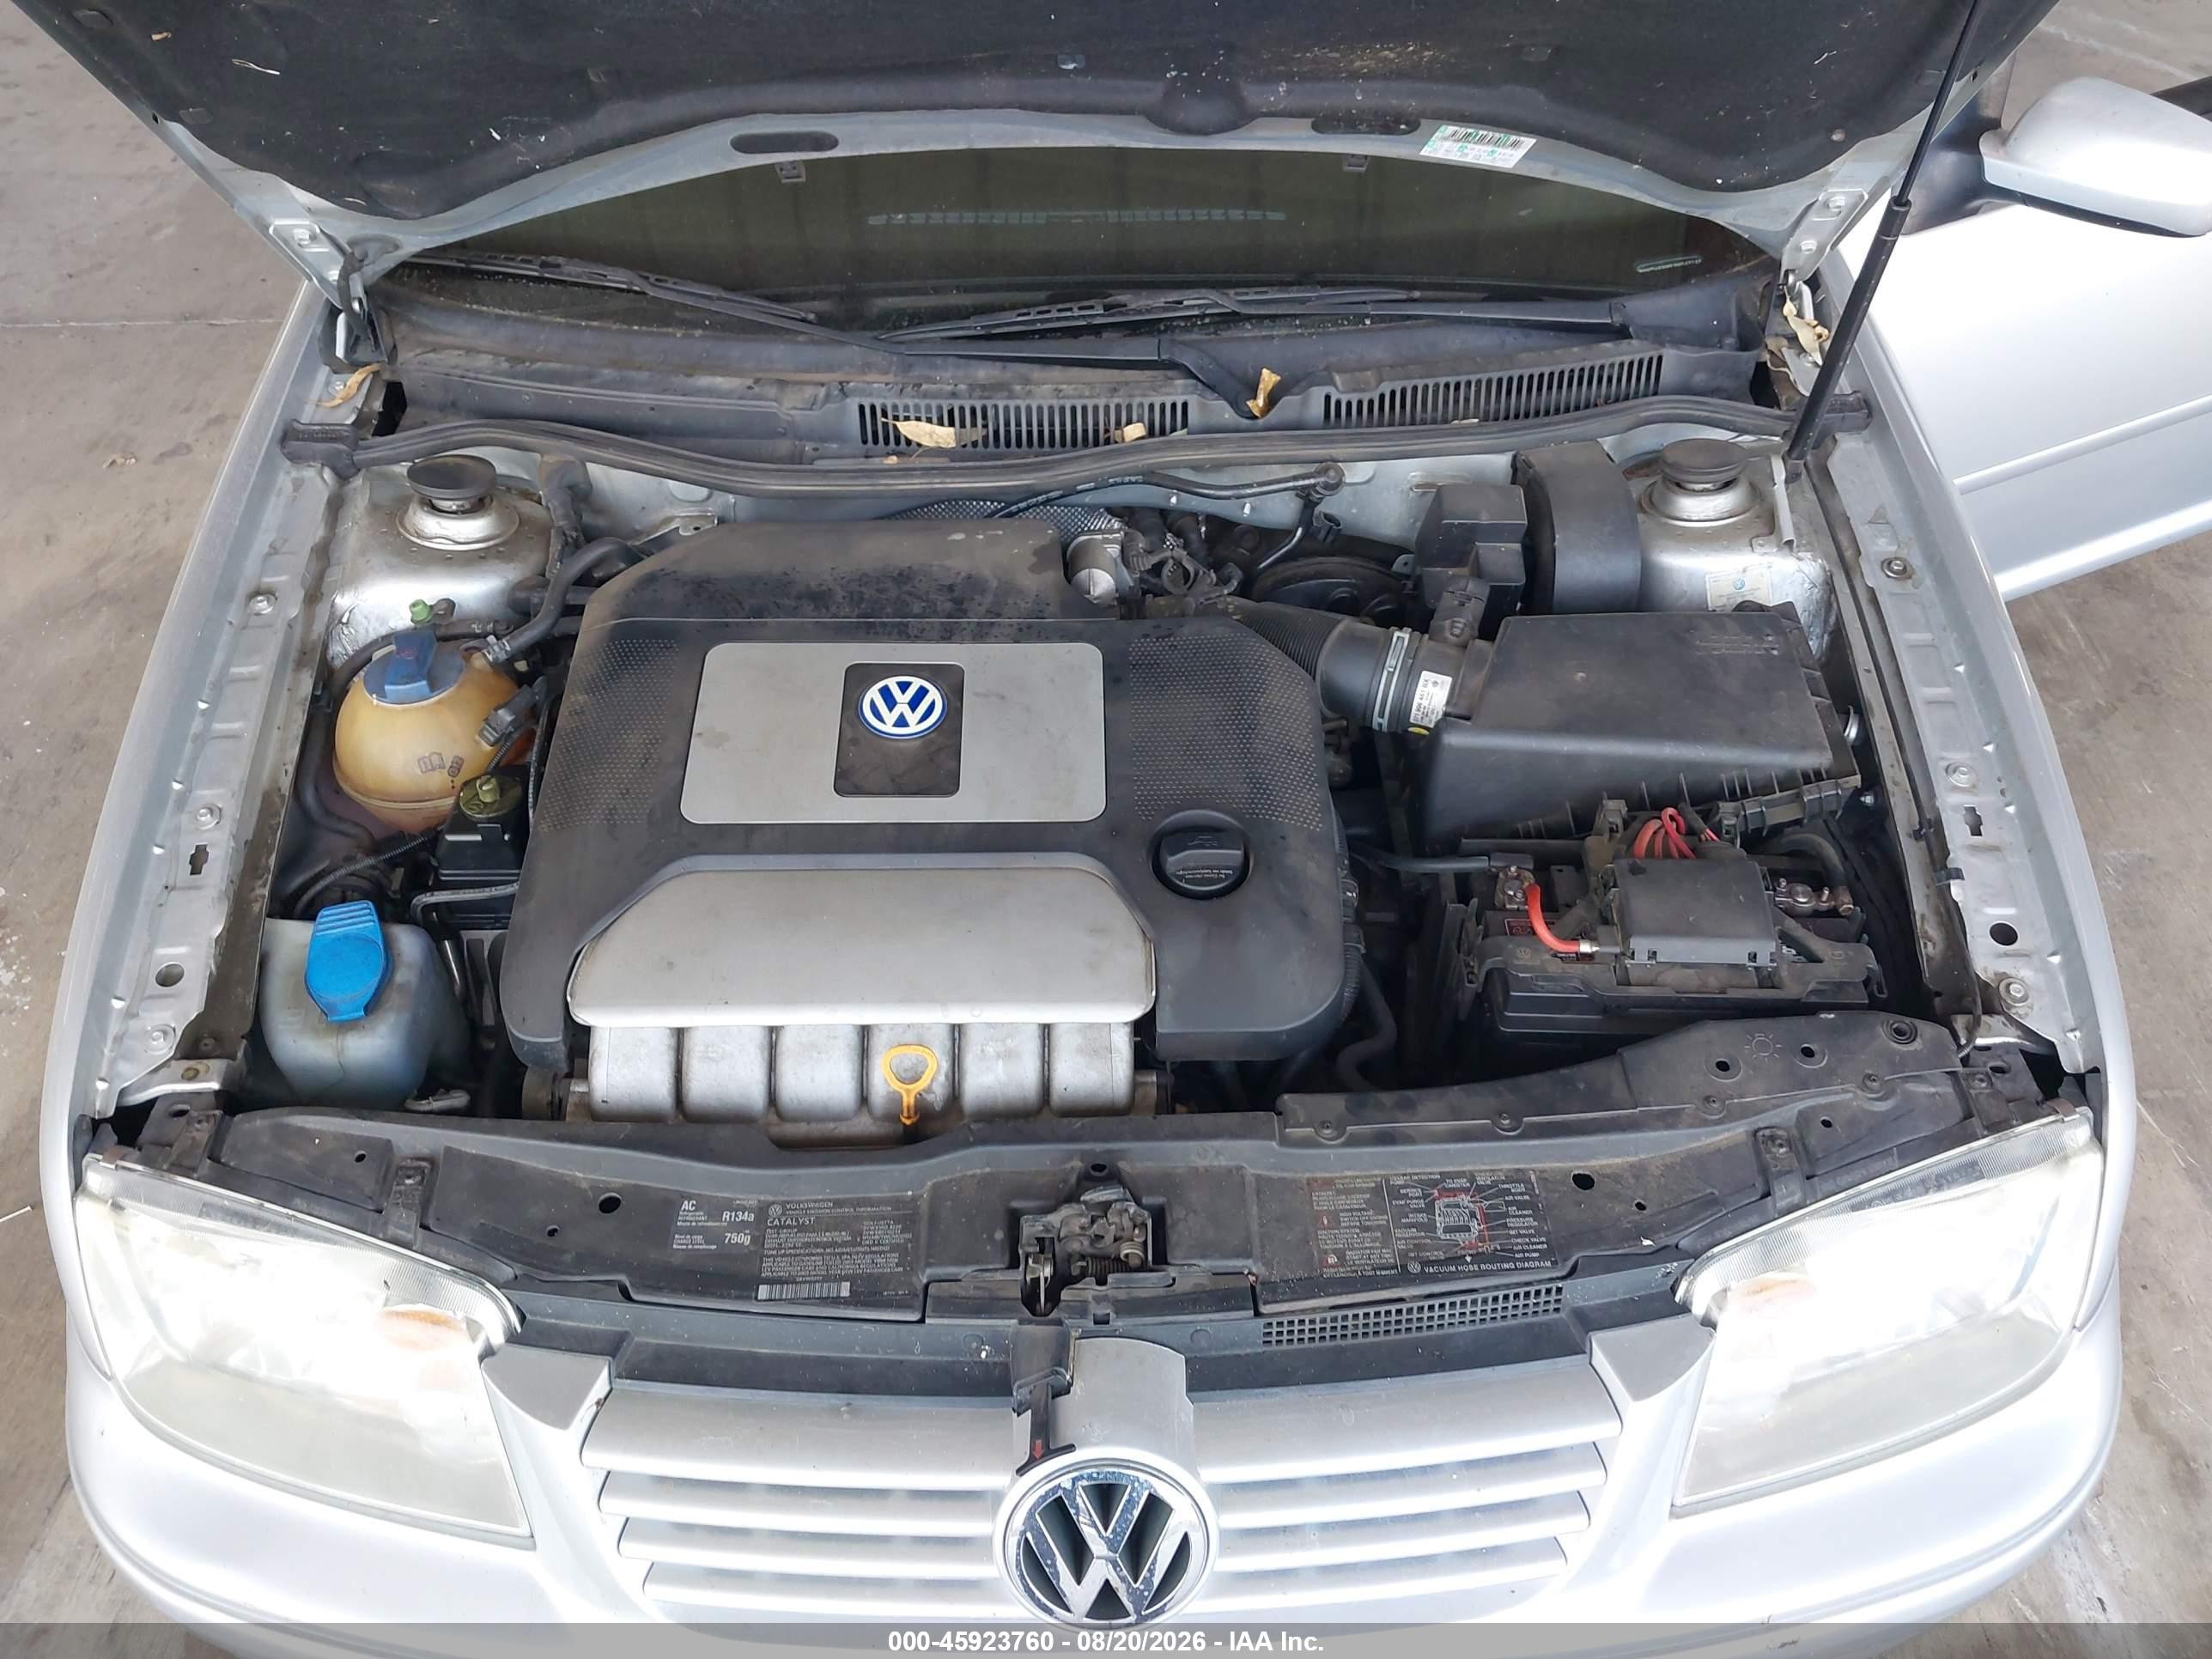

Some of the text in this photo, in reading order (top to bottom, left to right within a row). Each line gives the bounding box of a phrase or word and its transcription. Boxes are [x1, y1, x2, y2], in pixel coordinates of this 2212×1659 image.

[681, 1200, 696, 1211] AC
[722, 1211, 755, 1222] R134a
[767, 1217, 815, 1226] CATALYST
[725, 1232, 751, 1246] 750g
[1480, 1262, 1515, 1271] ROUTING
[1516, 1260, 1552, 1268] DIAGRAM
